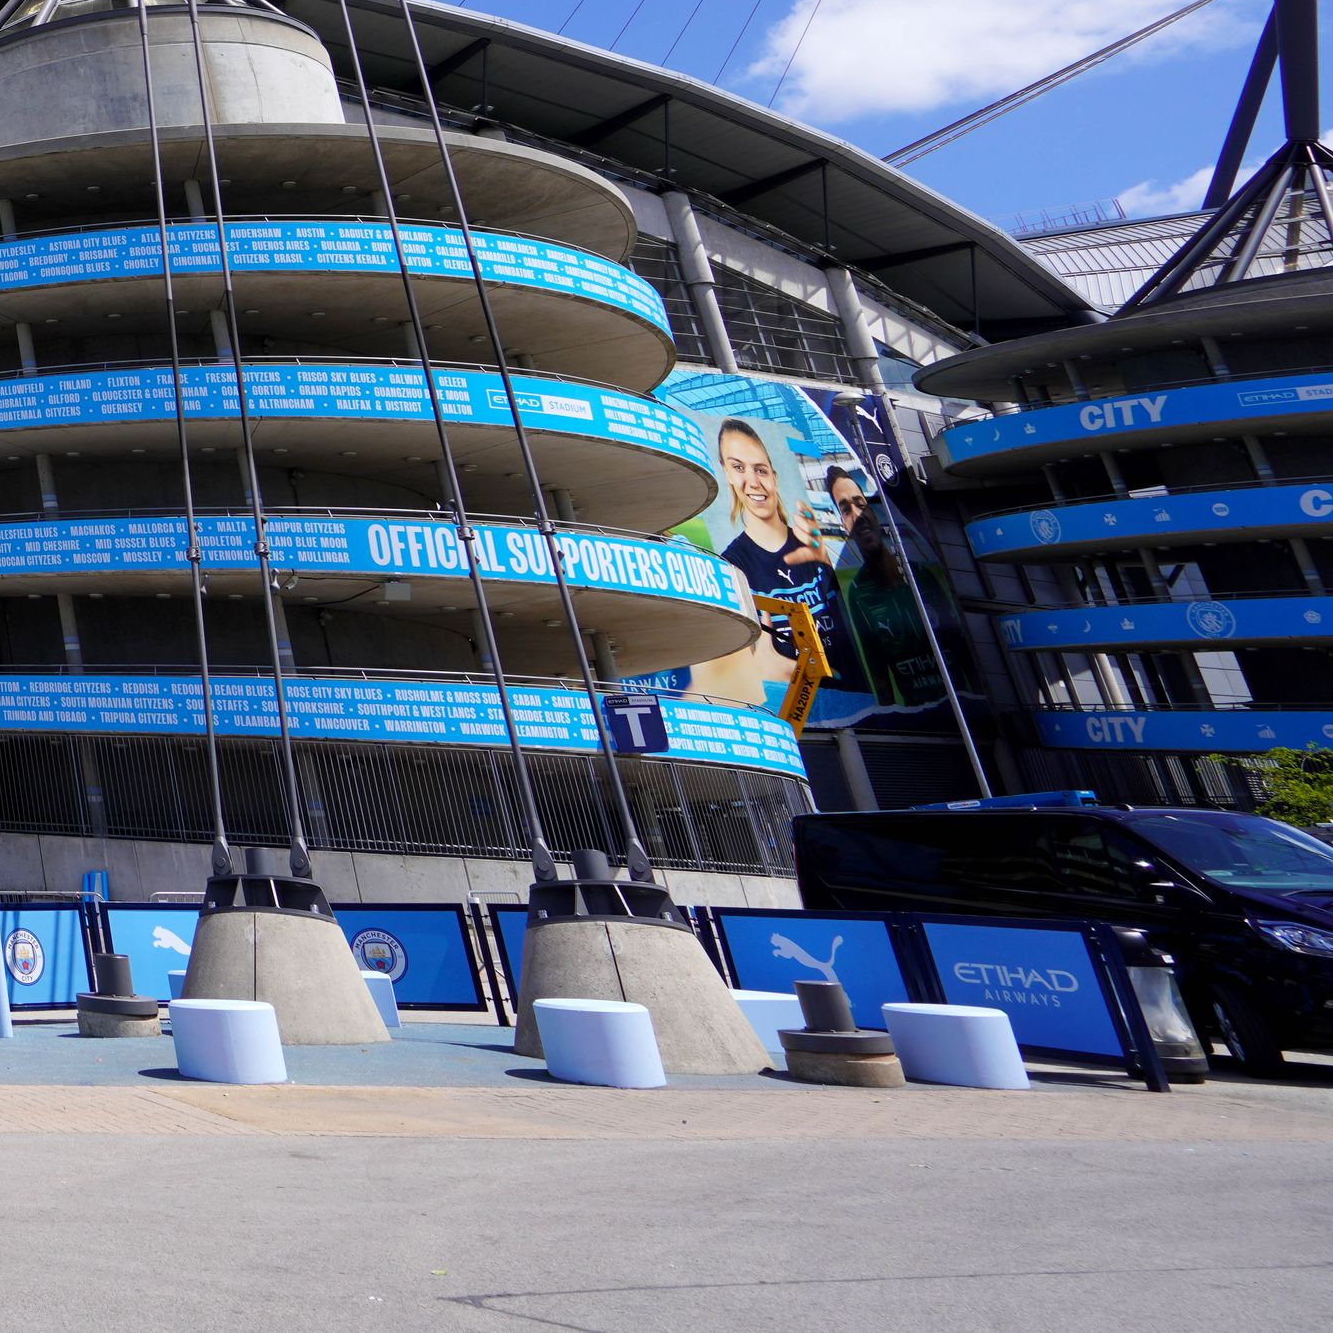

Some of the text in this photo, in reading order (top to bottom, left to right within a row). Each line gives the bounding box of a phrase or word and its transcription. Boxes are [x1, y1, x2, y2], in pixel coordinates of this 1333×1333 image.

[49, 240, 80, 251] ASTORIA
[83, 238, 99, 248] CITY
[103, 236, 127, 246] BLUES
[178, 230, 215, 241] CITYZENS
[231, 229, 281, 239] AUDENSHAW
[296, 229, 325, 238] AUSTIN
[29, 254, 68, 266] BREDBURY
[80, 250, 118, 260] BRISBANE
[252, 242, 284, 251] BUENOS
[286, 242, 309, 251] AIRES
[321, 241, 360, 251] BULGARIA
[372, 242, 392, 252] BURY
[86, 254, 386, 272] BLUES CHORLEY CINCINNATI CITIZENS BRASIL CITYZENS KERALA
[59, 379, 91, 391] FINLAND
[108, 376, 140, 387] FLIXTON
[297, 372, 327, 382] FRISCO
[331, 372, 347, 383] SKY
[350, 373, 376, 383] BLUES
[390, 374, 423, 385] GALWAY
[439, 376, 467, 387] GELEEN
[49, 394, 80, 404] GILFORD
[92, 388, 142, 401] GLOUCESTER
[252, 386, 286, 395] GORTON
[299, 385, 327, 395] GRAND
[330, 386, 361, 396] RAPIDS
[445, 390, 469, 402] MOON
[1244, 392, 1295, 402] ETIHAD
[0, 399, 473, 421] GUATEMALA CITYZENS GUERNSEY ALTRINCHAM HALIFAX DISTRICT HALTON
[549, 401, 586, 413] STADIUM
[1079, 394, 1169, 432] CITY
[35, 527, 58, 538] BLUES
[70, 525, 115, 536] MACHAKOS
[129, 523, 173, 534] MALLORCA
[217, 521, 247, 532] MALTA
[305, 523, 345, 534] CITYZENS
[44, 540, 80, 551] CHESHIRE
[115, 537, 146, 548] SUSSEX
[149, 536, 176, 547] BLUES
[296, 537, 316, 547] BLUE
[321, 537, 347, 548] MOON
[27, 554, 61, 565] CITYZENS
[73, 552, 110, 564] MOSCOW
[123, 551, 162, 562] MOSSLEY
[297, 551, 350, 563] MULLINGAR
[664, 551, 721, 600] CLUBS
[30, 682, 72, 693] REDBRIDGE
[74, 683, 111, 694] CITYZENS
[123, 683, 159, 694] REDDISH
[215, 685, 243, 695] BEACH
[247, 685, 274, 696] BLUES
[287, 686, 311, 698] ROSE
[313, 687, 331, 699] CITY
[335, 688, 352, 699] SKY
[355, 689, 383, 700] BLUES
[395, 689, 443, 702] RUSHOLME
[455, 691, 479, 704] MOSS
[513, 694, 541, 706] SABAH
[793, 678, 815, 722] HA20PX
[61, 697, 570, 724] SOUTH MORAVIAN CITYZENS STAFFS YORKSHIRE SOUTHPORT WEST LANCS BLUES
[56, 711, 505, 736] TOBAGO TRIPURA CITYZENS VANCOUVER WARRINGTON WARWICK
[614, 707, 653, 748] T
[1086, 716, 1146, 742] CITY
[355, 932, 399, 950] MANCHESTER
[953, 962, 1079, 993] ETIHAD
[985, 988, 1061, 1008] AIRWAYS
